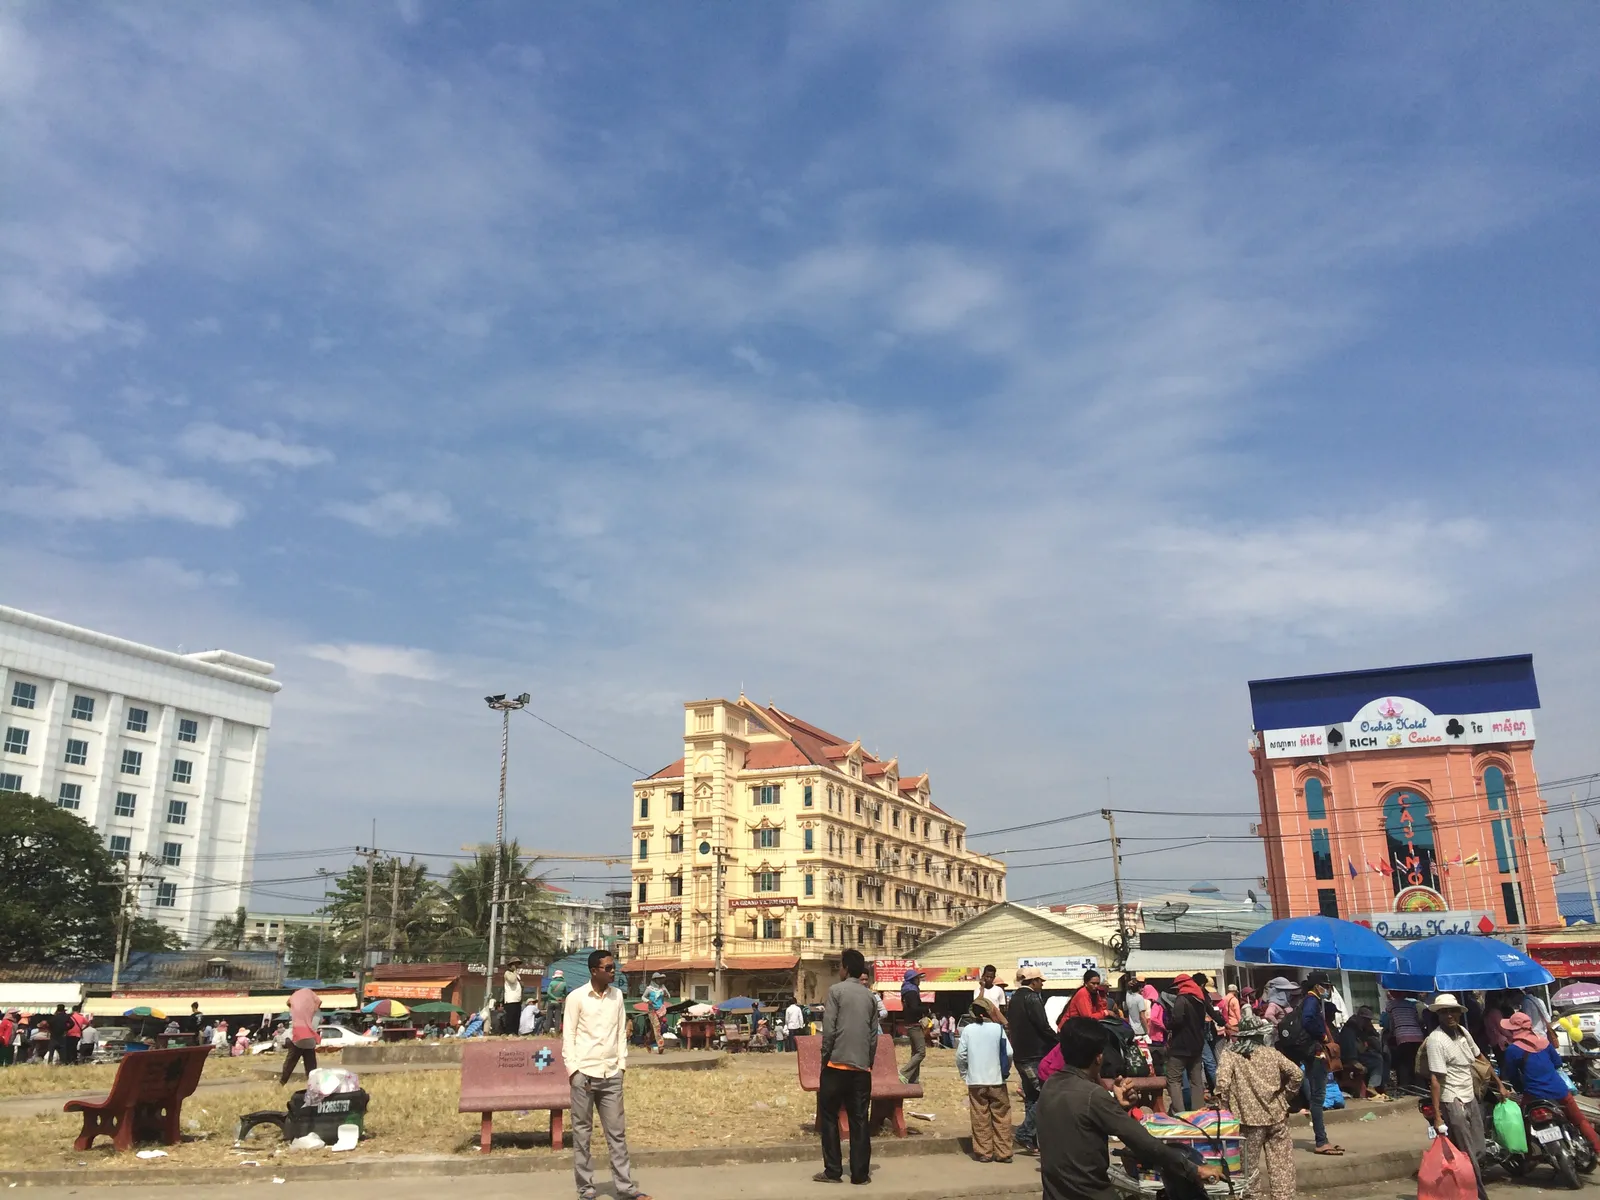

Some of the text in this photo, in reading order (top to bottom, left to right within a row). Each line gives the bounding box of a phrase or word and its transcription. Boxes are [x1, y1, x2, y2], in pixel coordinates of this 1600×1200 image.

[1360, 718, 1427, 732] Orchid Hotel
[1350, 731, 1442, 748] RICH Casino
[1398, 794, 1424, 885] CASINO
[1376, 920, 1470, 938] Orchid Hotel
